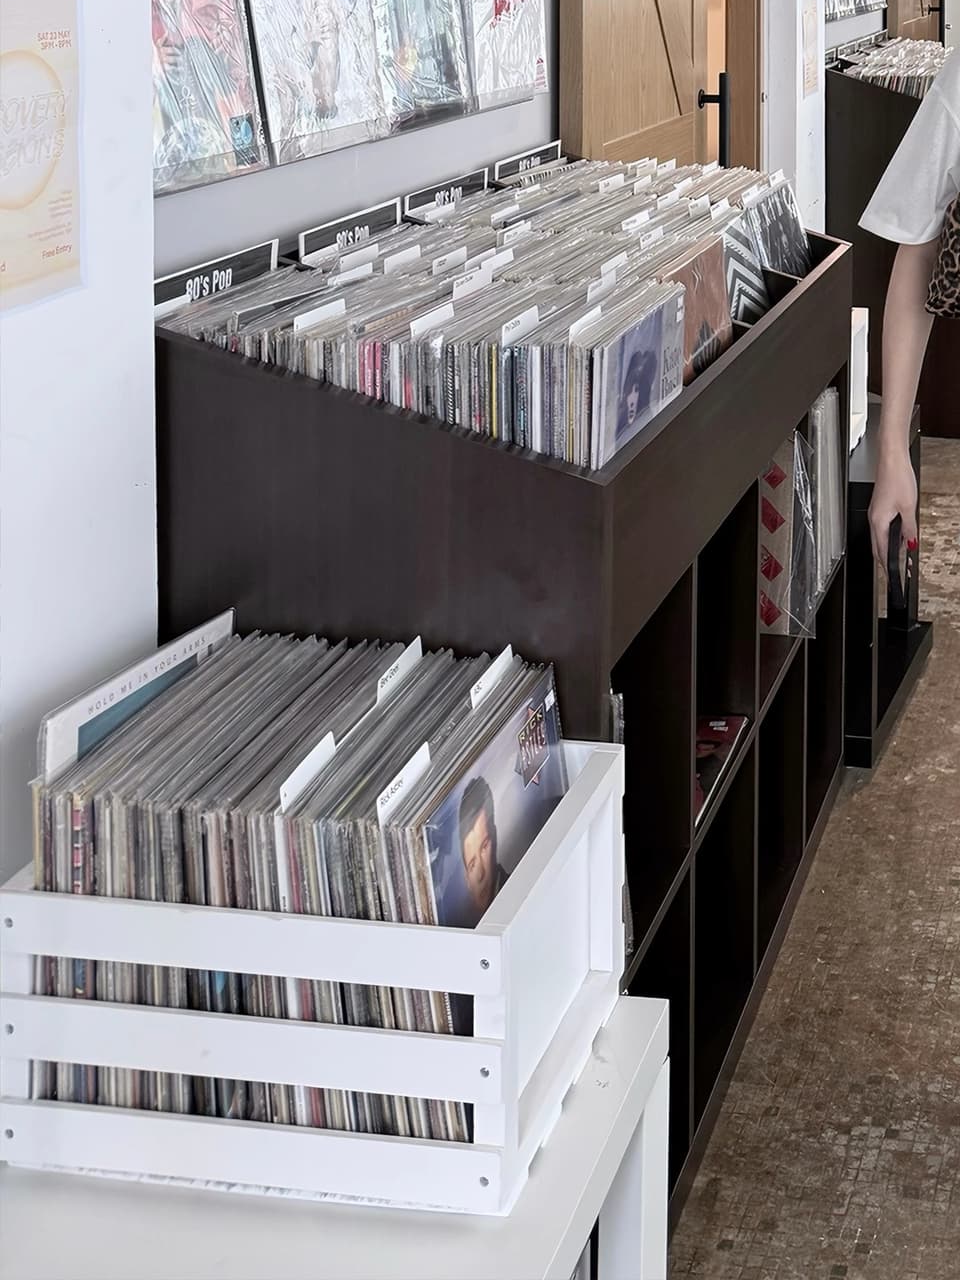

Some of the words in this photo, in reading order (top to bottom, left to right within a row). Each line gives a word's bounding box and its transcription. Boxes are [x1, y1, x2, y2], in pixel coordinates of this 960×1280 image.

[186, 275, 210, 300] 80's
[213, 268, 232, 293] Pop
[87, 693, 114, 716] HOLD
[120, 681, 133, 694] ME
[138, 673, 148, 684] IN
[154, 654, 177, 672] YOUR
[183, 638, 206, 655] ARMS
[519, 712, 543, 744] RICK
